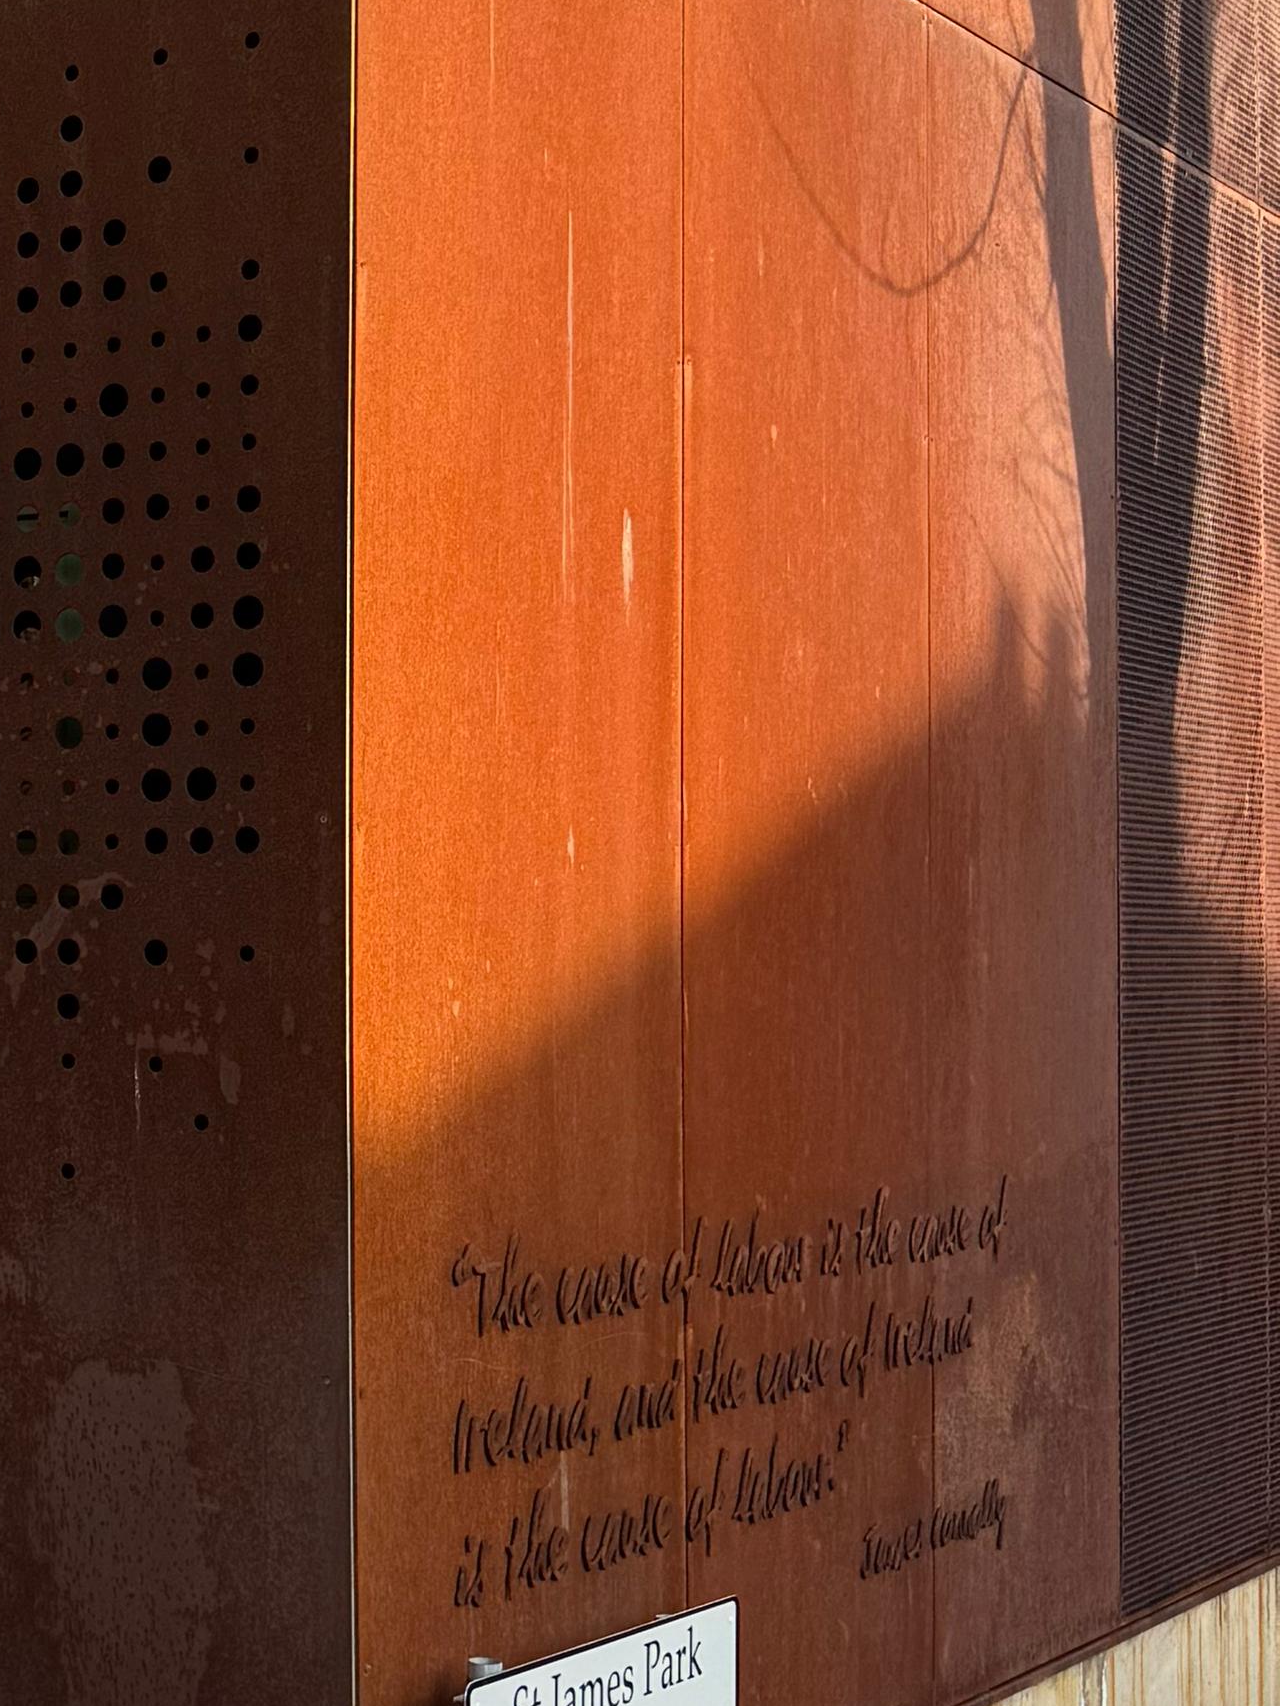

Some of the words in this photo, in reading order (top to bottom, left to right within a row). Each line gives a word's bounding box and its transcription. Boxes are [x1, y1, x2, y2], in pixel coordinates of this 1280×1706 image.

[556, 1253, 648, 1325] cause
[662, 1215, 706, 1325] of
[820, 1217, 846, 1277] is
[854, 1185, 901, 1275] the
[909, 1204, 971, 1264] cause
[979, 1173, 1008, 1264] of
[614, 1359, 681, 1442] and
[693, 1324, 745, 1424] the
[756, 1338, 831, 1405] cause
[841, 1300, 875, 1399] of
[454, 1535, 485, 1608] is
[504, 1488, 569, 1602] the
[580, 1493, 672, 1573] cause
[684, 1447, 729, 1558] of
[643, 1625, 703, 1696] Park
